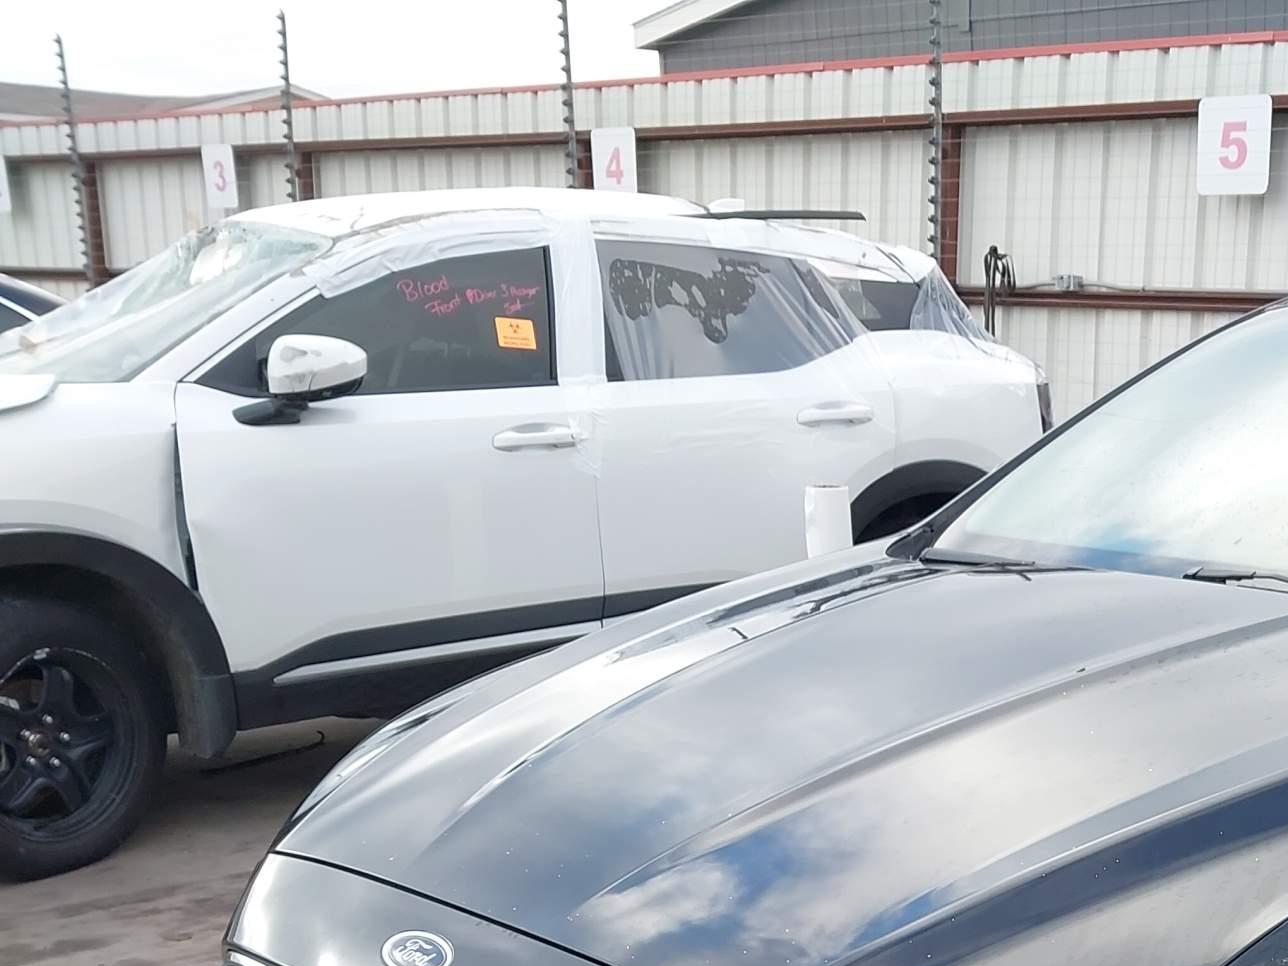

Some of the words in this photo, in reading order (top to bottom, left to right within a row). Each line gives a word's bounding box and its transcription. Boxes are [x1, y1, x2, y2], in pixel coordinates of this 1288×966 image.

[1218, 122, 1248, 169] 5
[212, 160, 225, 193] 3
[606, 144, 625, 184] 4
[396, 275, 449, 302] Blood
